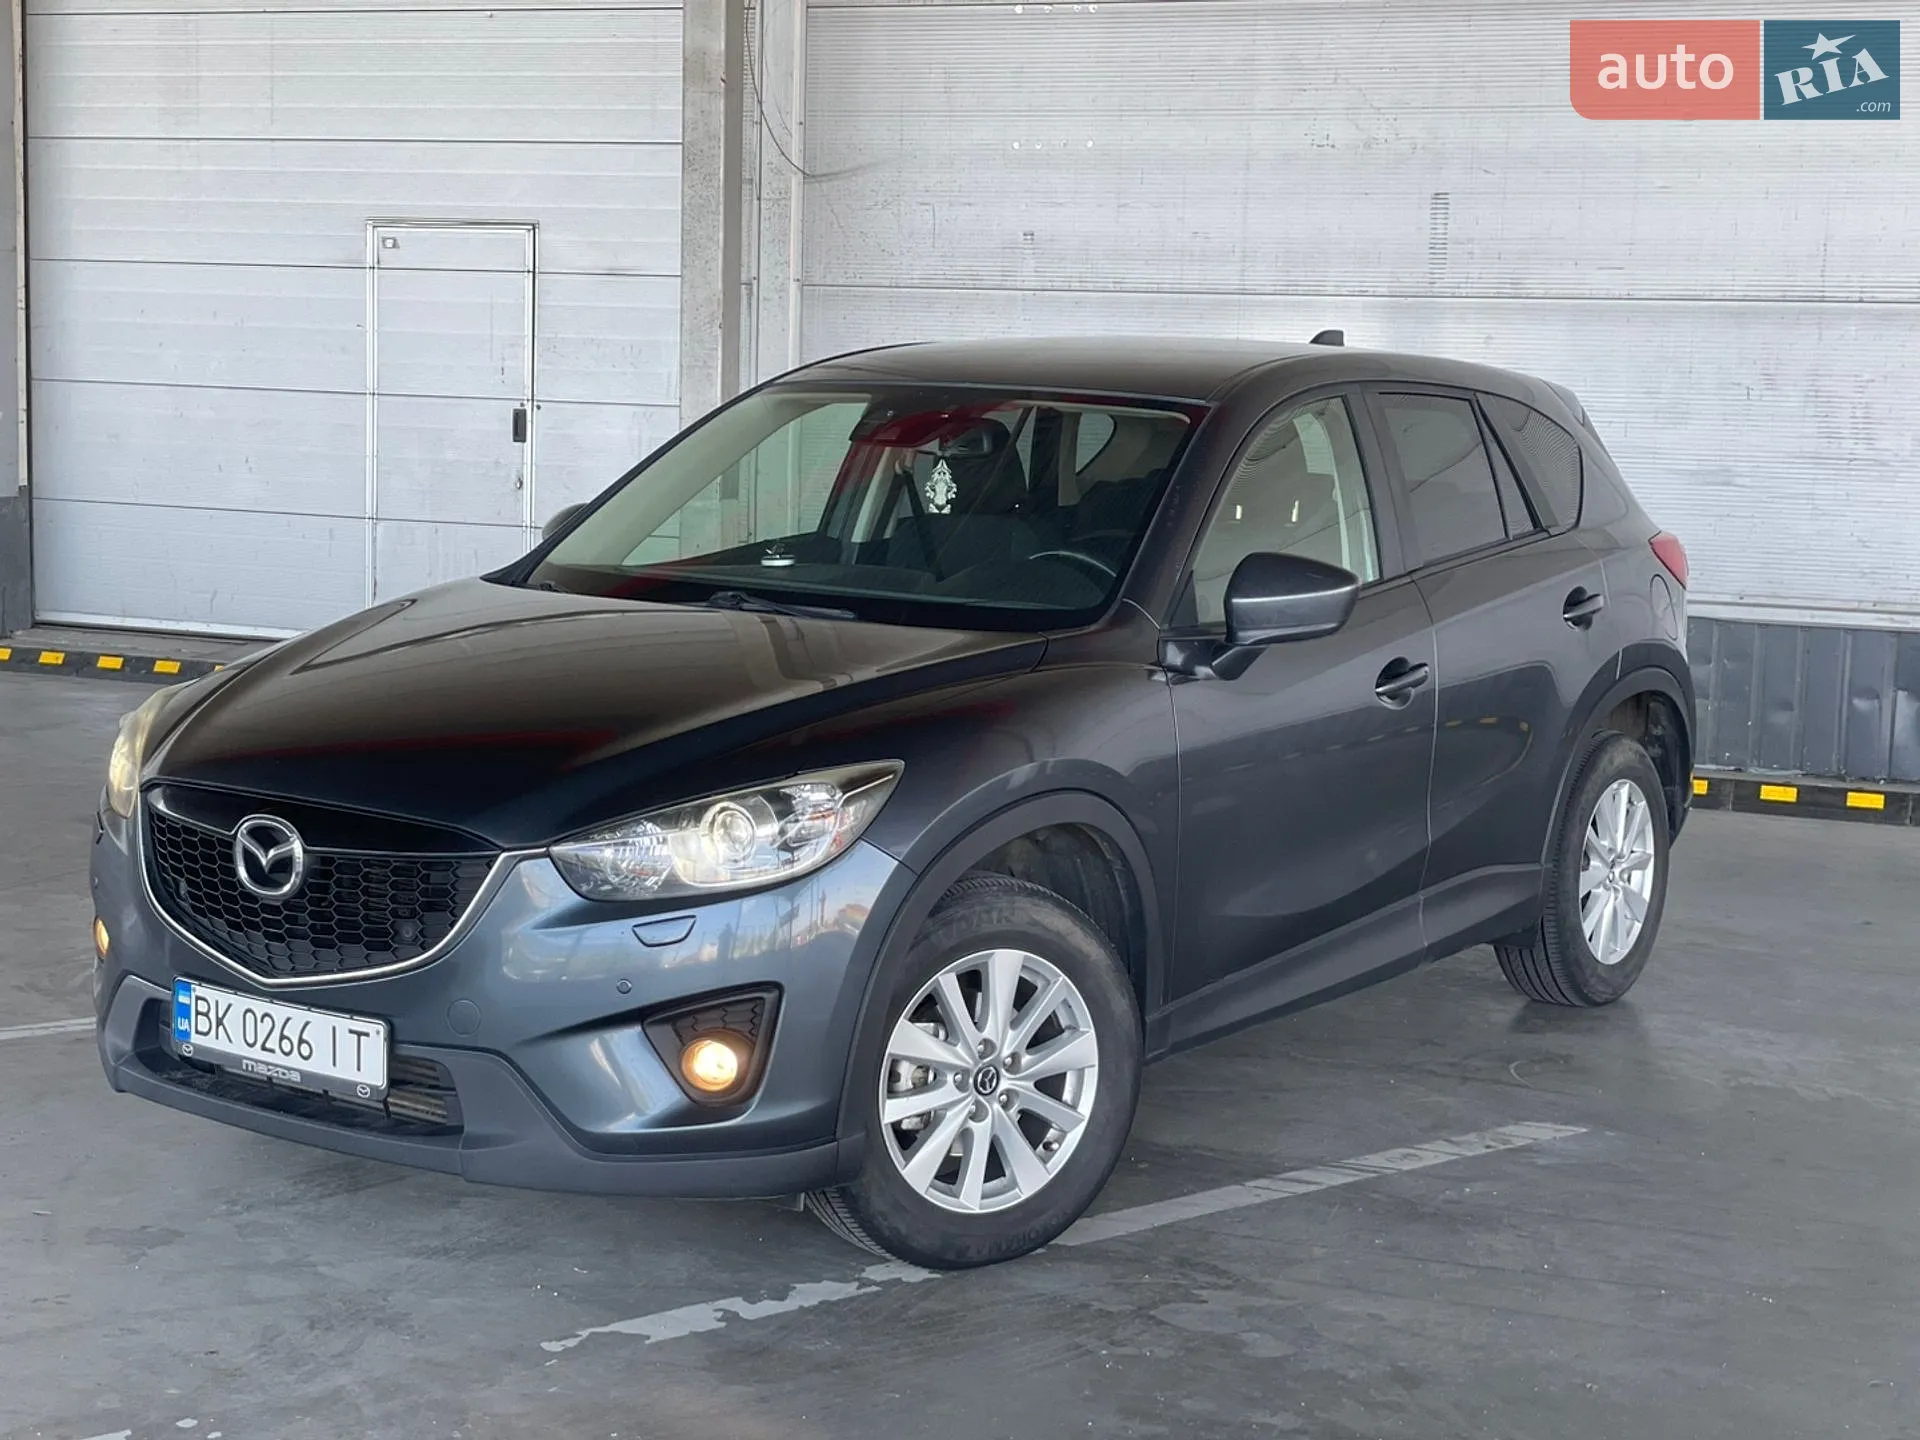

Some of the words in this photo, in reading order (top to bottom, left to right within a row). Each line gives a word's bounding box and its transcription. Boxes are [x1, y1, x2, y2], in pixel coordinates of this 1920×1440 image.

[177, 1016, 191, 1033] UA
[194, 994, 233, 1044] BK
[242, 1007, 313, 1061] 0266
[331, 1024, 370, 1072] IT
